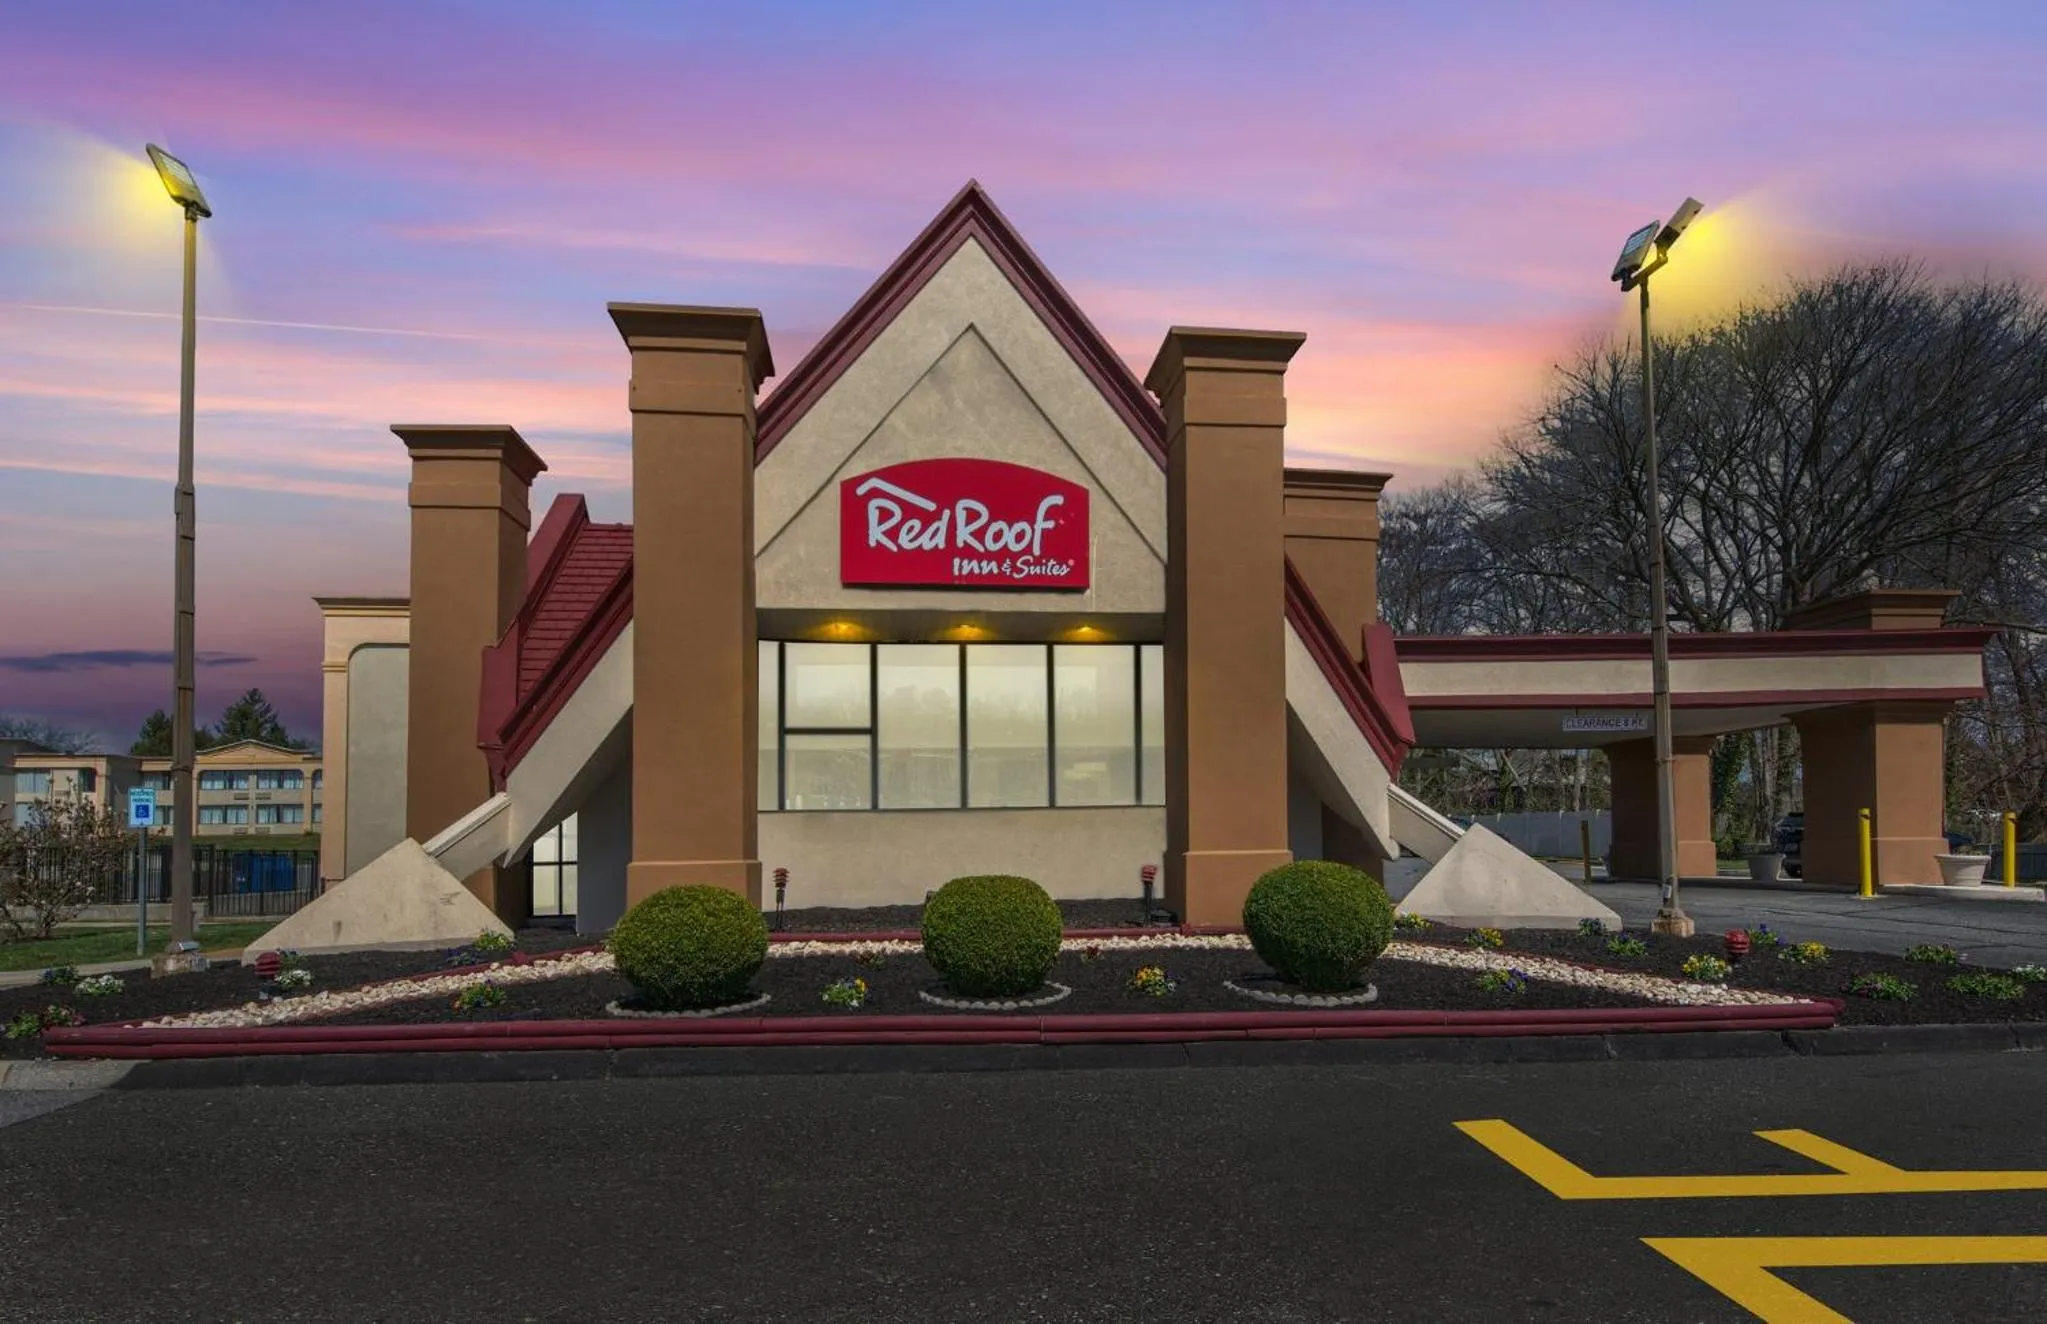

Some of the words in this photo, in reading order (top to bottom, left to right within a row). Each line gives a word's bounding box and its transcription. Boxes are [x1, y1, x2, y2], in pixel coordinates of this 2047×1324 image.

[867, 497, 950, 552] Red
[955, 494, 1064, 556] Roof
[1001, 558, 1011, 577] &
[1013, 555, 1071, 578] Suites
